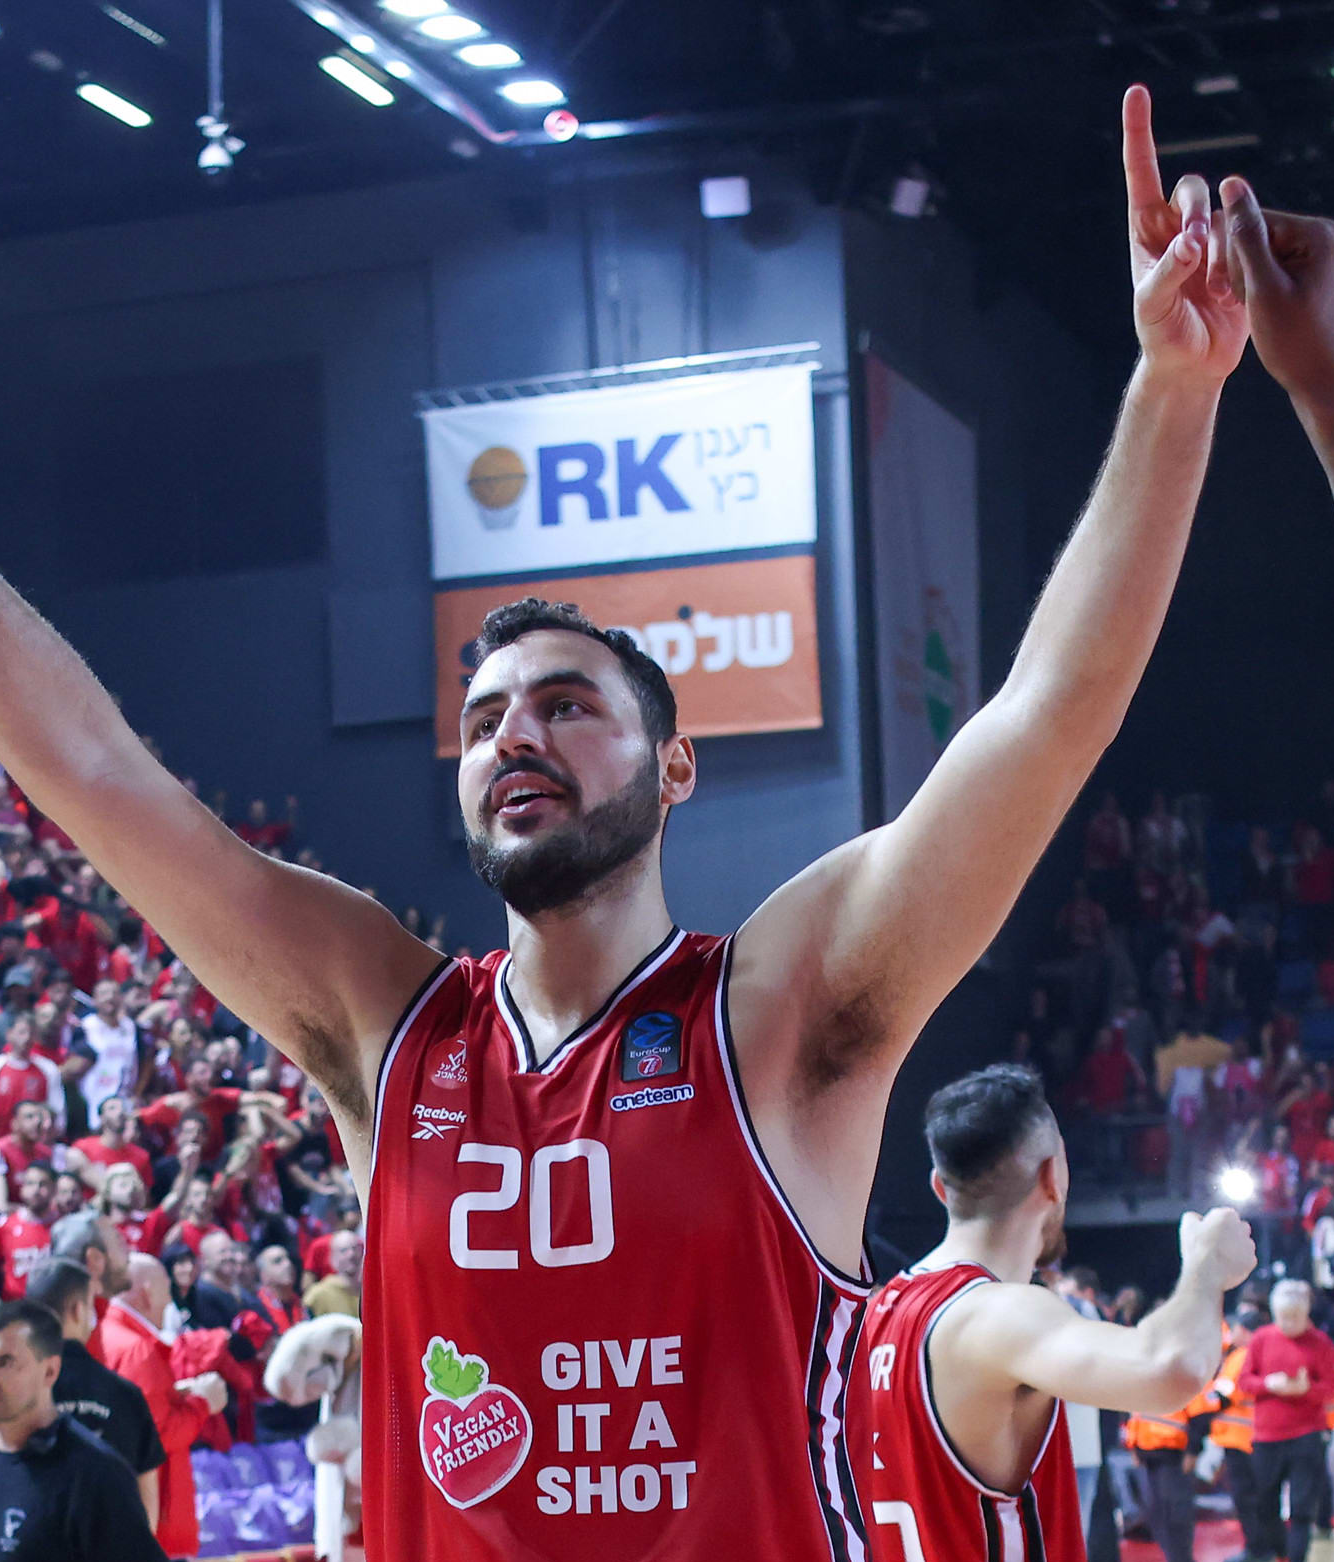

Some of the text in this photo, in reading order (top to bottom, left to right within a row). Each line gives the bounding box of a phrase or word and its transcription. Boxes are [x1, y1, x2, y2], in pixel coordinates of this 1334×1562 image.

[537, 432, 692, 526] RK
[609, 611, 794, 675] שלמ
[412, 1104, 467, 1123] Reebok
[612, 1086, 693, 1110] oneteam
[449, 1138, 615, 1270] 20
[541, 1335, 684, 1390] GIVE
[432, 1416, 520, 1480] FRIENDLY
[433, 1400, 506, 1449] VEGAN
[558, 1401, 678, 1452] IT A
[537, 1461, 697, 1514] SHOT
